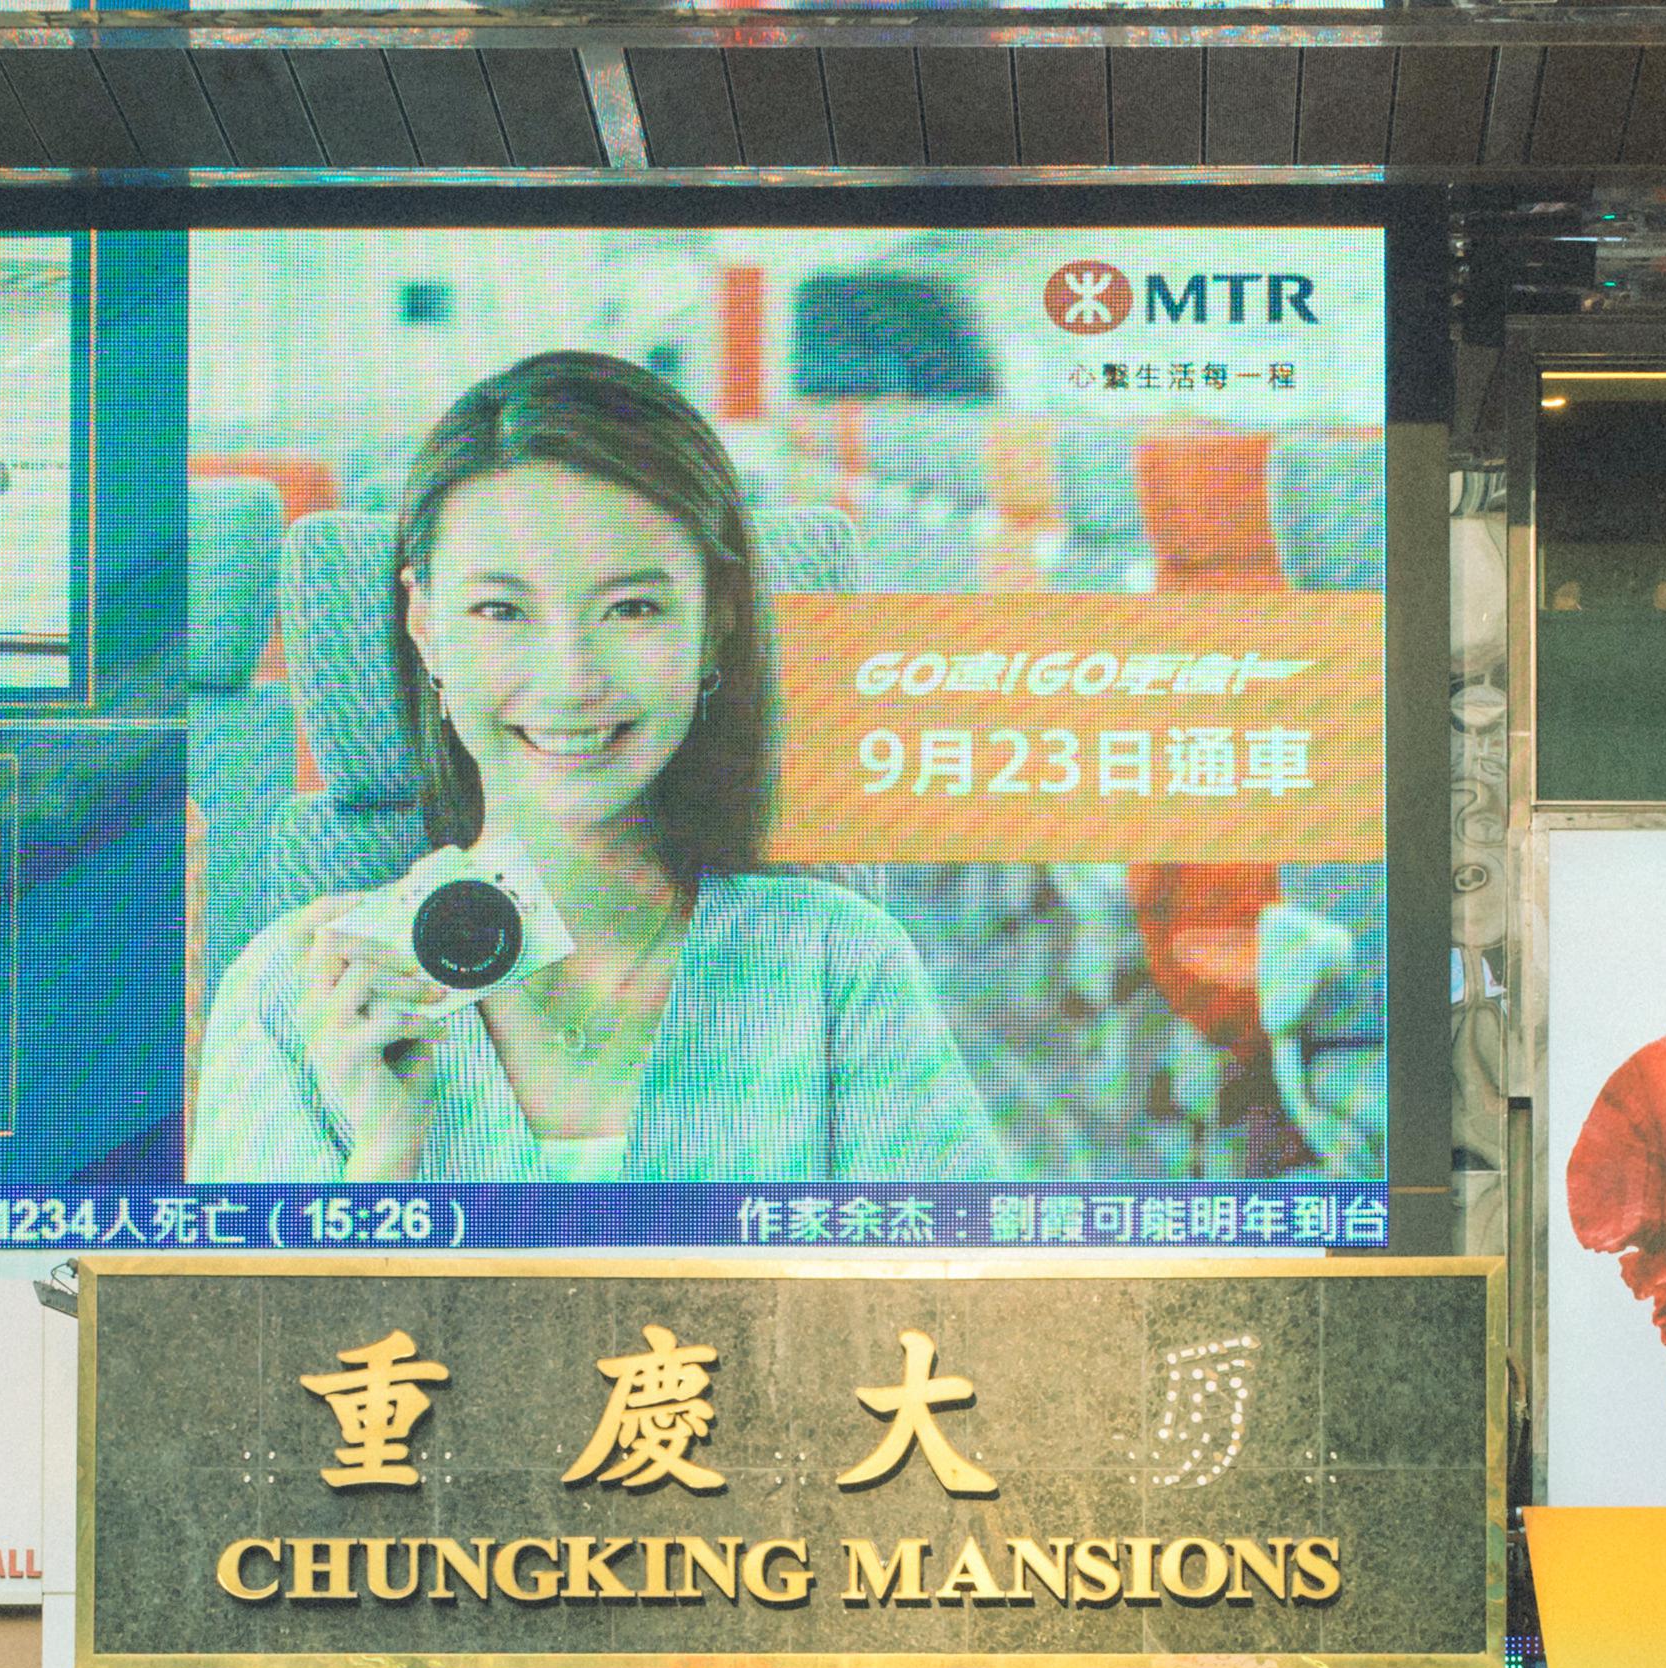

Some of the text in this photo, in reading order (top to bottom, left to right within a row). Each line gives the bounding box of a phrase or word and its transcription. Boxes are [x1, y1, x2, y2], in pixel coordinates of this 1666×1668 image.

[1145, 274, 1319, 324] MTR
[1068, 363, 1297, 391] 心繫生活每一程
[857, 727, 1316, 796] 9月23日通車
[216, 1536, 1343, 1605] CHUNGKING MANSIONS
